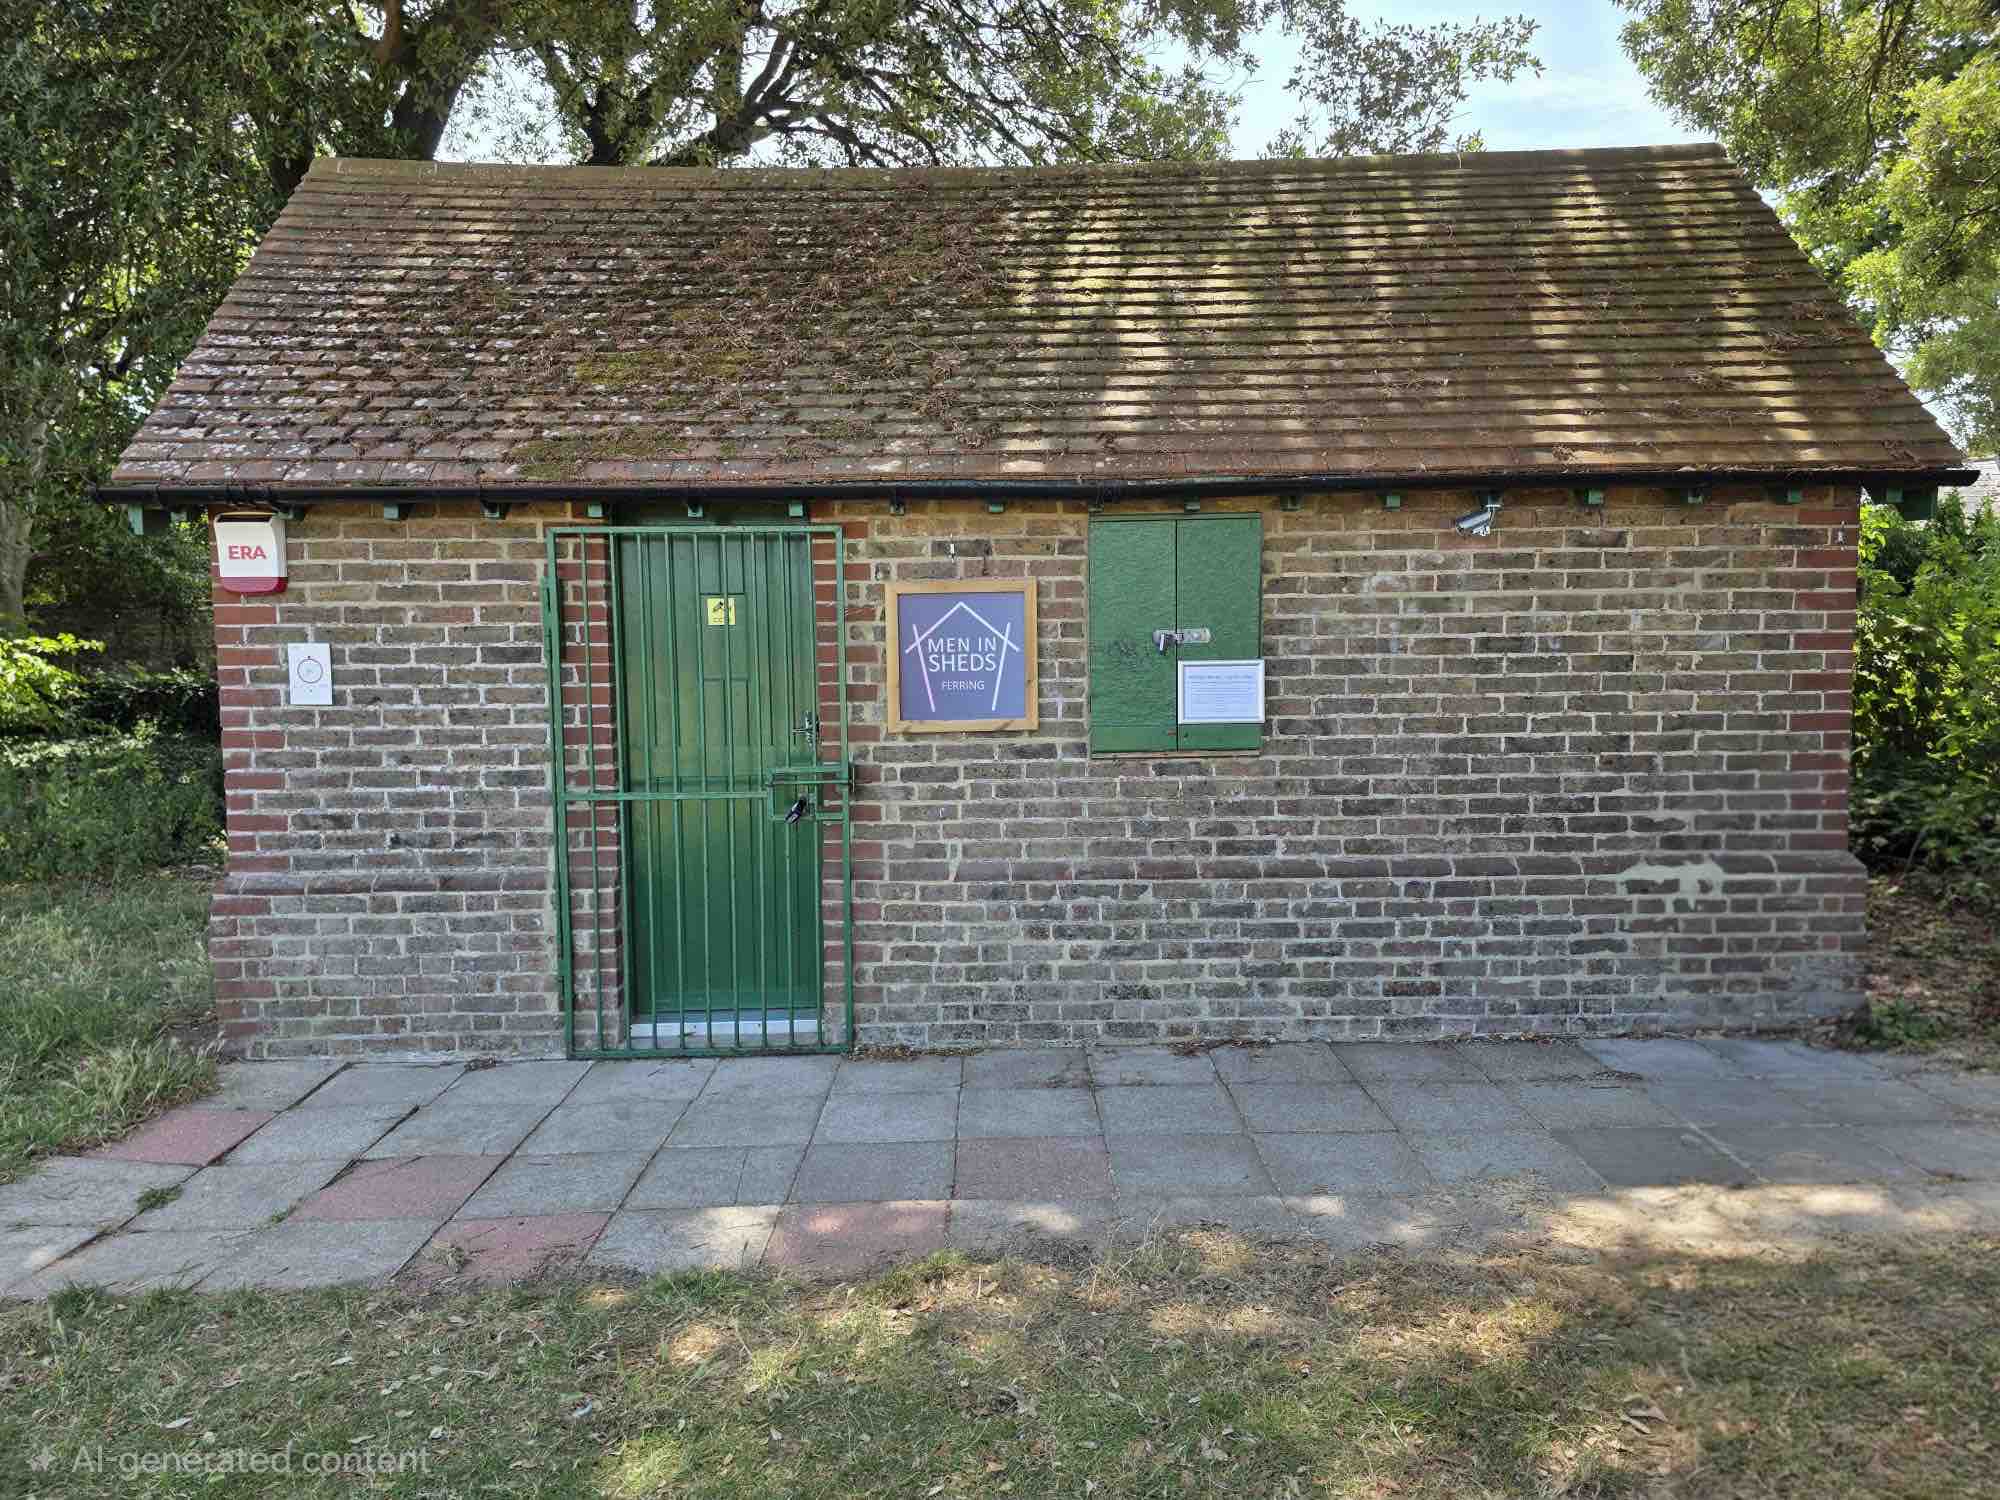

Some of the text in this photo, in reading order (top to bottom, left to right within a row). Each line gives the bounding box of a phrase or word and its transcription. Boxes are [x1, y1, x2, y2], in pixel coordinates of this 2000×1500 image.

[228, 545, 267, 560] ERA
[928, 637, 997, 652] MEN IN
[928, 653, 998, 672] SHEDS
[942, 680, 985, 690] FERRING
